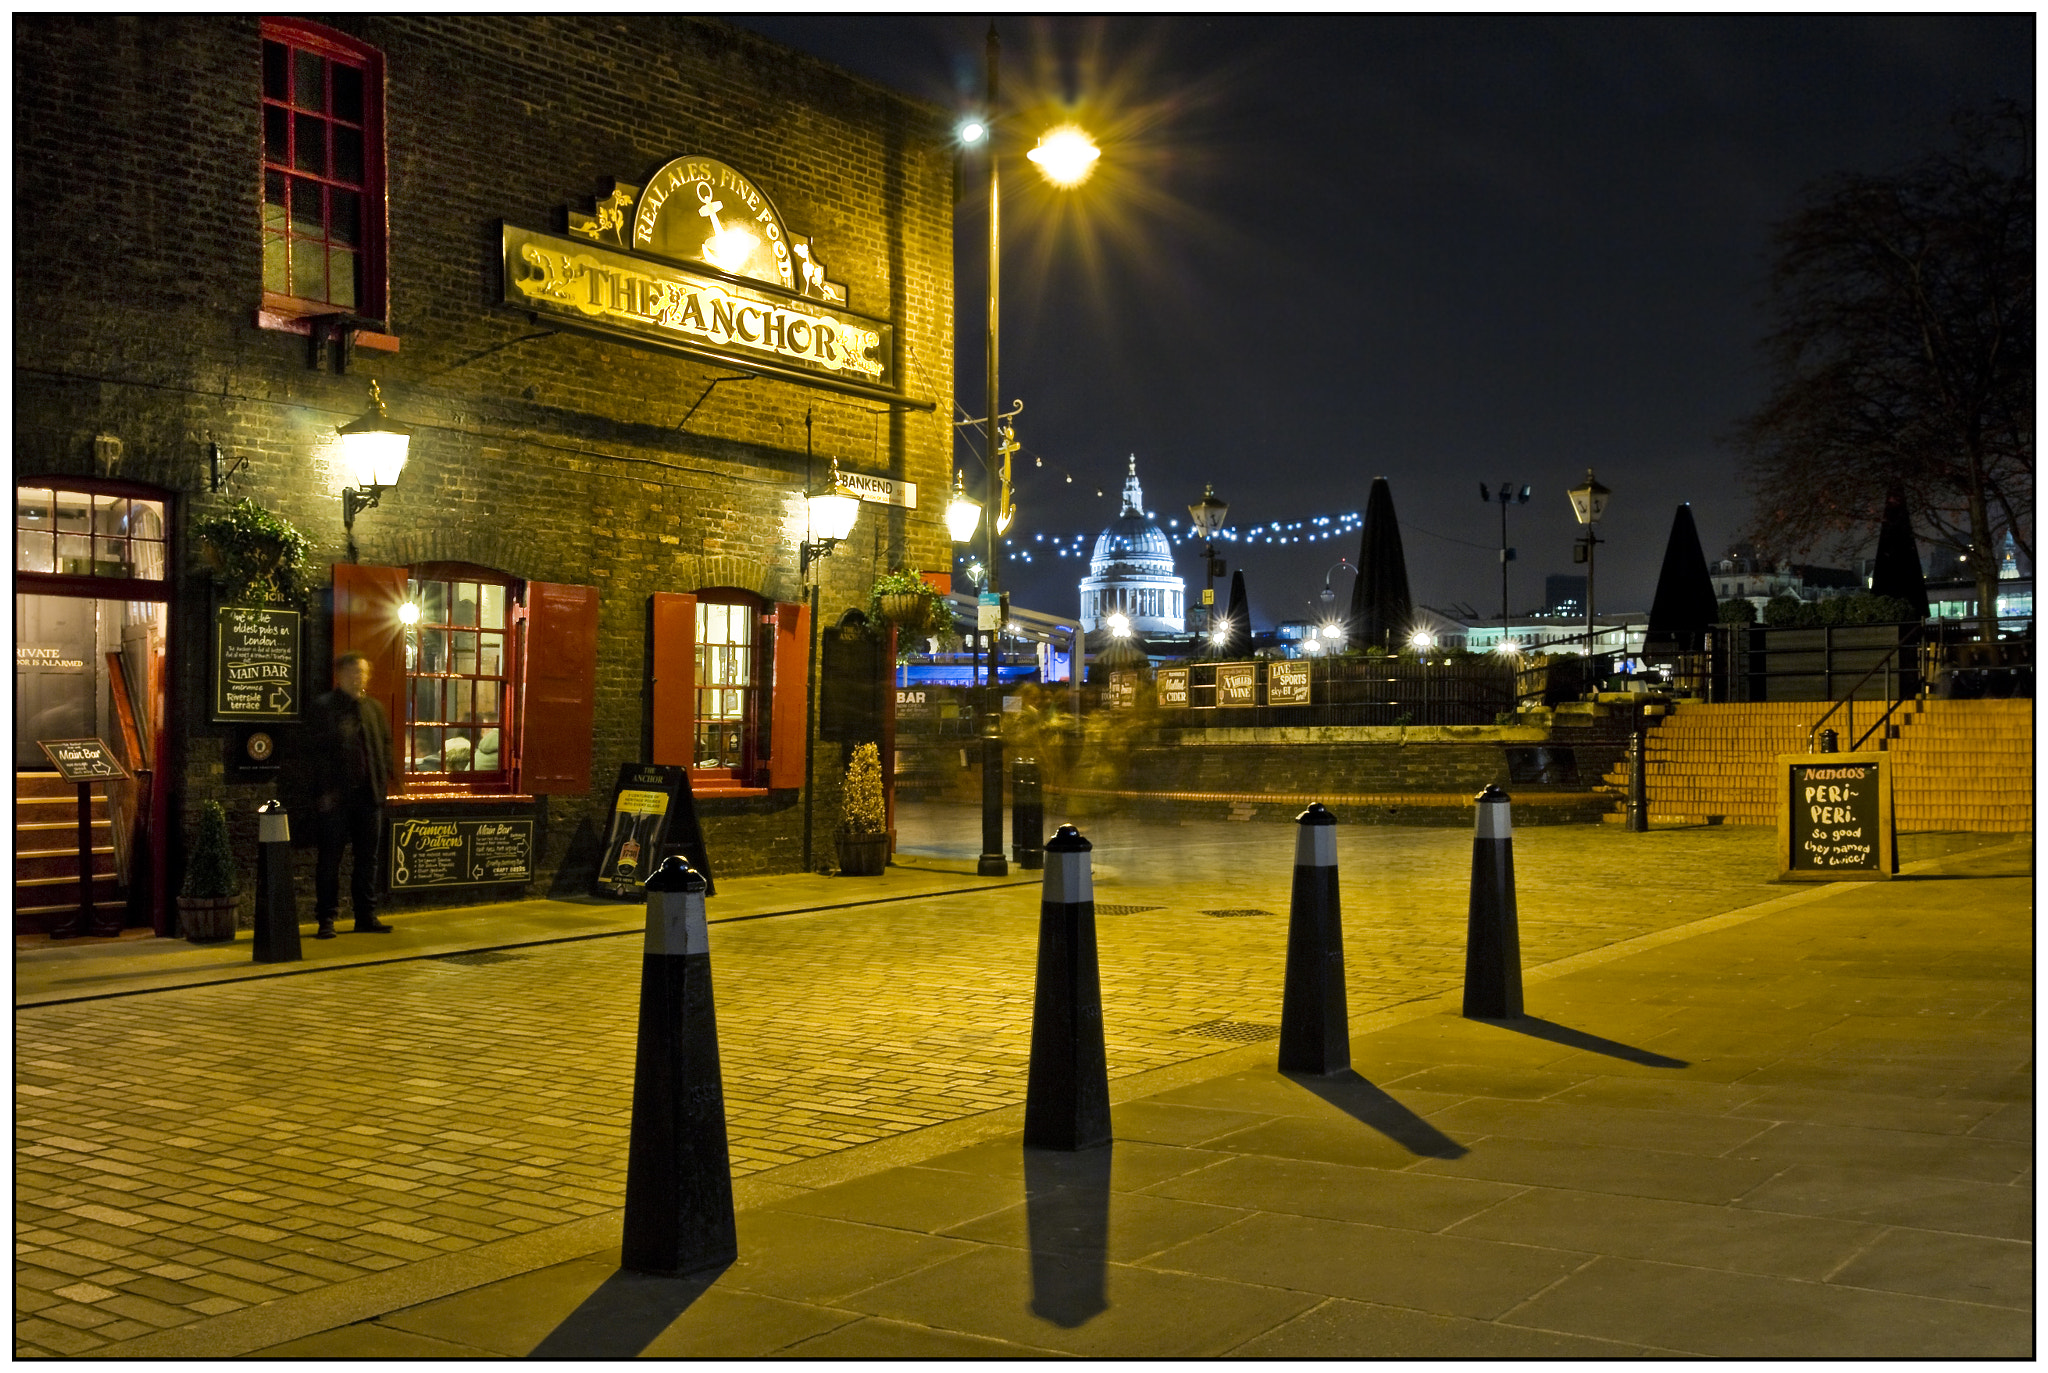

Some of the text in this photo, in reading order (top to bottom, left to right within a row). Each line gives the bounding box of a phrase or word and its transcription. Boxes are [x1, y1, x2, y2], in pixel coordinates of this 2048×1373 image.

[638, 162, 792, 279] REAL ALES, FINE FOOD
[579, 263, 838, 362] THE ANCHOR
[842, 474, 893, 495] BANKEND
[1204, 591, 1213, 604] H
[233, 623, 290, 636] oldest pubs in
[42, 659, 84, 667] ALARMED
[229, 665, 289, 679] MAIN BAR
[1273, 664, 1291, 677] LIVE
[1223, 675, 1252, 690] MULLED
[1280, 673, 1307, 686] SPORTS
[226, 692, 262, 702] Riverside
[1166, 691, 1186, 702] CIDER
[1230, 687, 1251, 698] WINE
[1283, 686, 1291, 695] BT
[896, 691, 926, 704] BAR
[230, 700, 260, 710] terrace
[59, 748, 101, 760] Main Bar
[632, 774, 664, 784] ANCHOR
[400, 819, 458, 847] Famous
[476, 824, 496, 836] Main
[496, 823, 513, 835] Bar
[1832, 827, 1862, 841] good
[415, 834, 463, 850] Patrons
[1804, 840, 1871, 855] they named
[1813, 853, 1866, 866] it twice!
